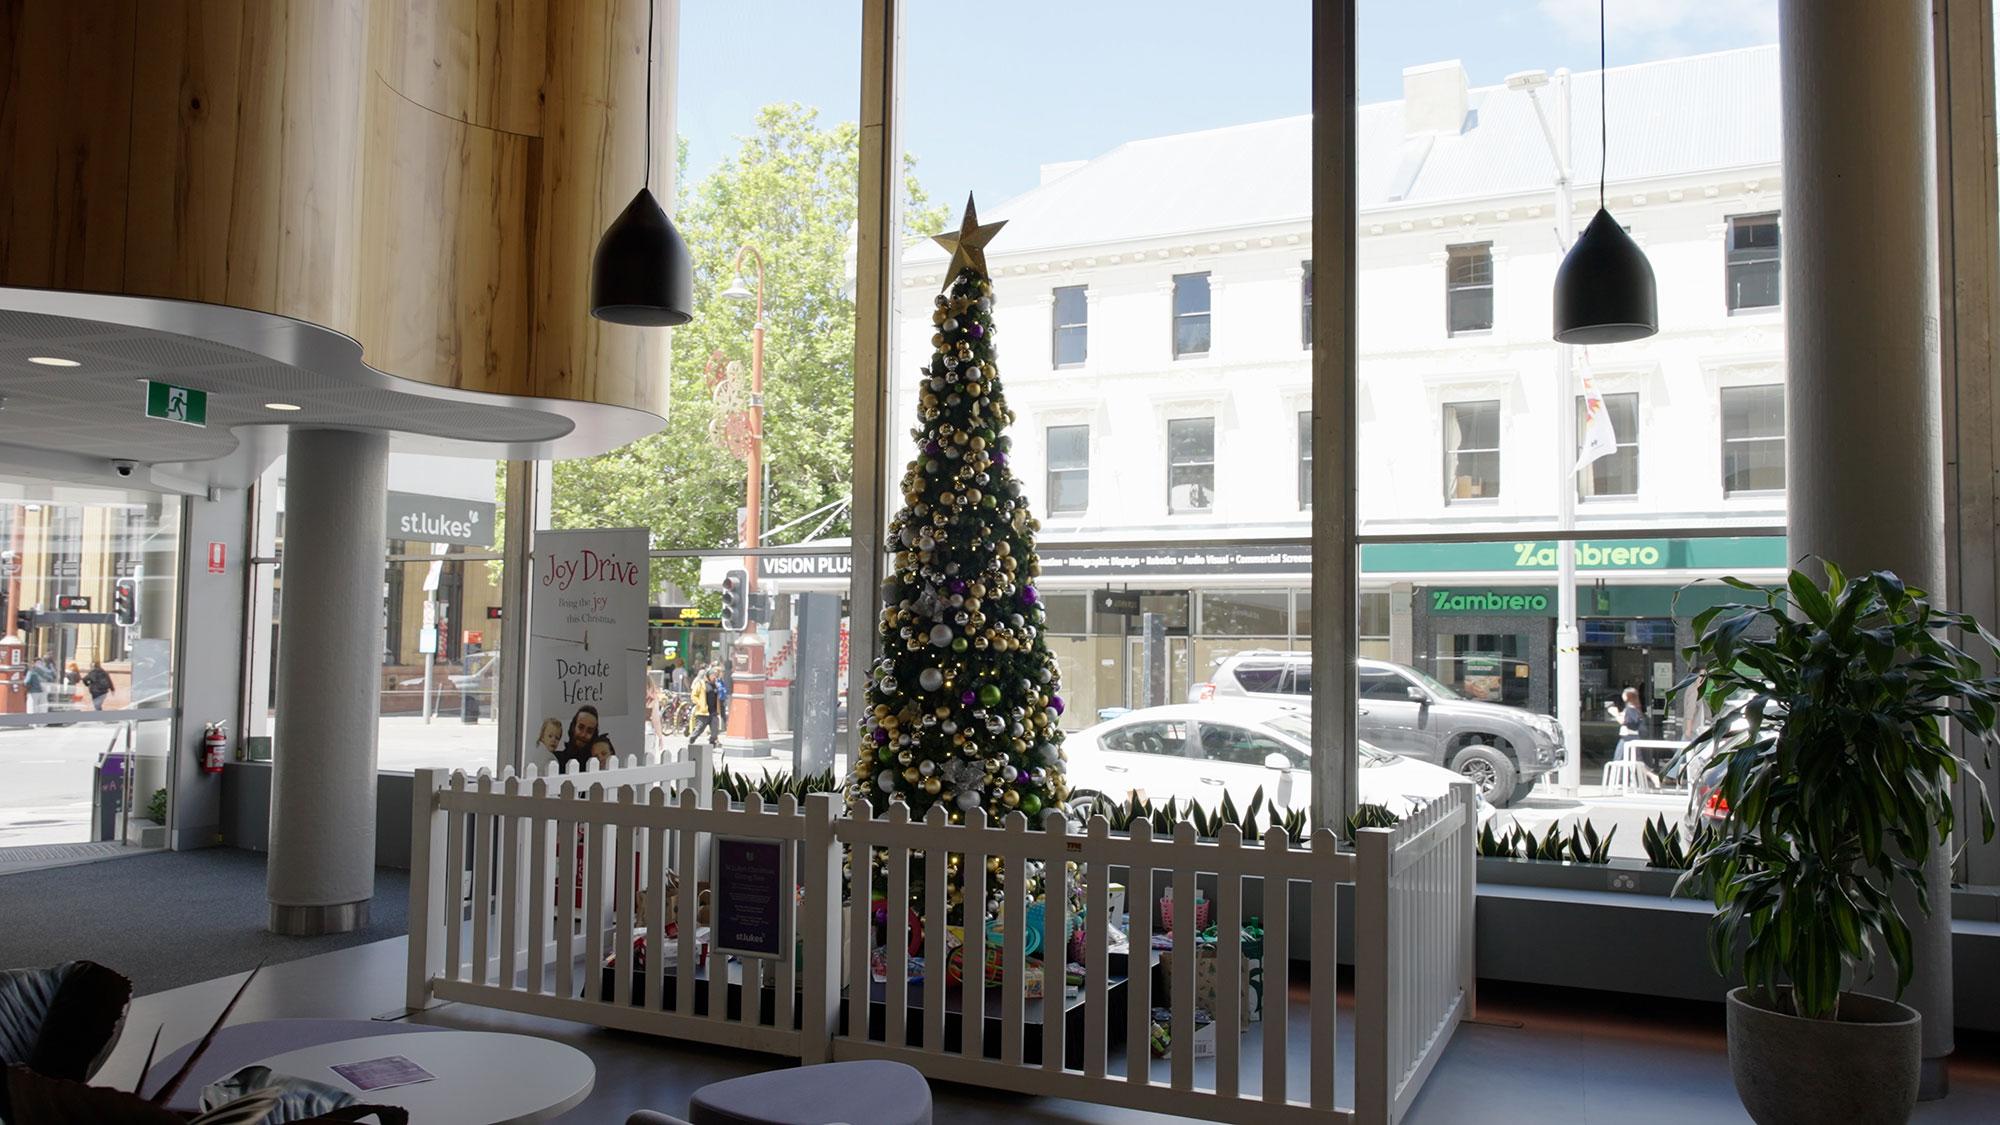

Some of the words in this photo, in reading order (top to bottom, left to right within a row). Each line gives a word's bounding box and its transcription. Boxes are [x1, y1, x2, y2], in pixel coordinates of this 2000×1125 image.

[400, 512, 472, 539] st.lukes
[543, 554, 579, 591] Joy
[582, 550, 639, 586] Drive
[763, 557, 815, 574] VISION
[1069, 557, 1110, 568] Holographic
[1111, 556, 1140, 568] Displays
[1146, 556, 1177, 565] Robotics
[1183, 555, 1205, 564] Audio
[1206, 555, 1229, 564] Visual
[1236, 554, 1281, 564] Commercial
[71, 598, 88, 607] nab
[558, 598, 578, 609] Bring
[579, 597, 591, 607] the
[591, 592, 608, 612] joy
[1434, 591, 1548, 611] Zambrero
[566, 614, 581, 624] this
[581, 613, 617, 625] Christmas
[556, 659, 611, 680] Donate
[563, 679, 604, 704] Here!
